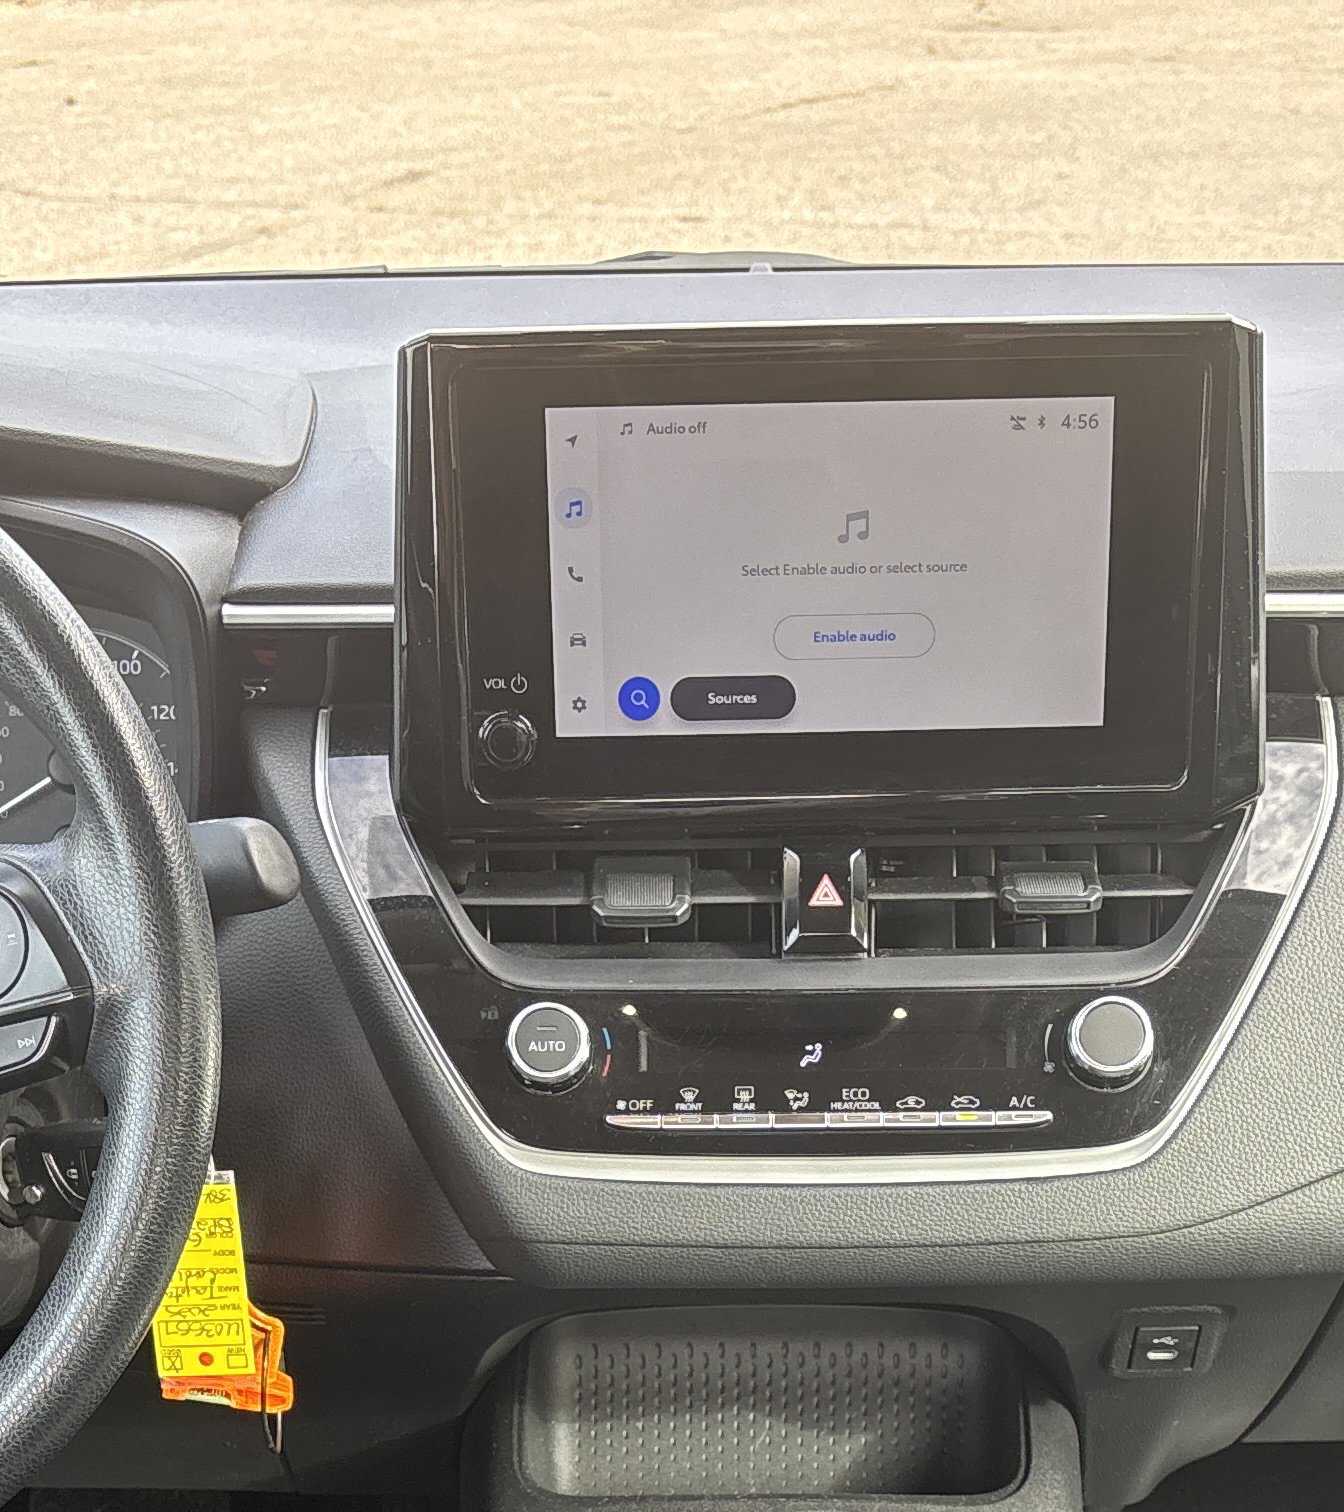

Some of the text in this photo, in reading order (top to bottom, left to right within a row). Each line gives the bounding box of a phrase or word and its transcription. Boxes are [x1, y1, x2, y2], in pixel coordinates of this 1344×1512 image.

[646, 420, 707, 435] Audio off
[1061, 413, 1099, 431] 4:56
[742, 561, 967, 577] Select Enable audio or select source
[813, 629, 896, 644] Enable audio
[484, 677, 507, 690] VOL
[707, 690, 757, 705] Sources
[528, 1040, 566, 1052] AUTO
[842, 1087, 870, 1101] ECO
[628, 1099, 654, 1111] OFF
[675, 1102, 703, 1111] FRONT
[733, 1102, 756, 1111] REAR
[830, 1101, 881, 1111] HEAT/COOL
[1008, 1095, 1035, 1109] A/C
[213, 1249, 236, 1257] BODY
[217, 1285, 240, 1293] MAKE
[220, 1302, 242, 1311] YEAR
